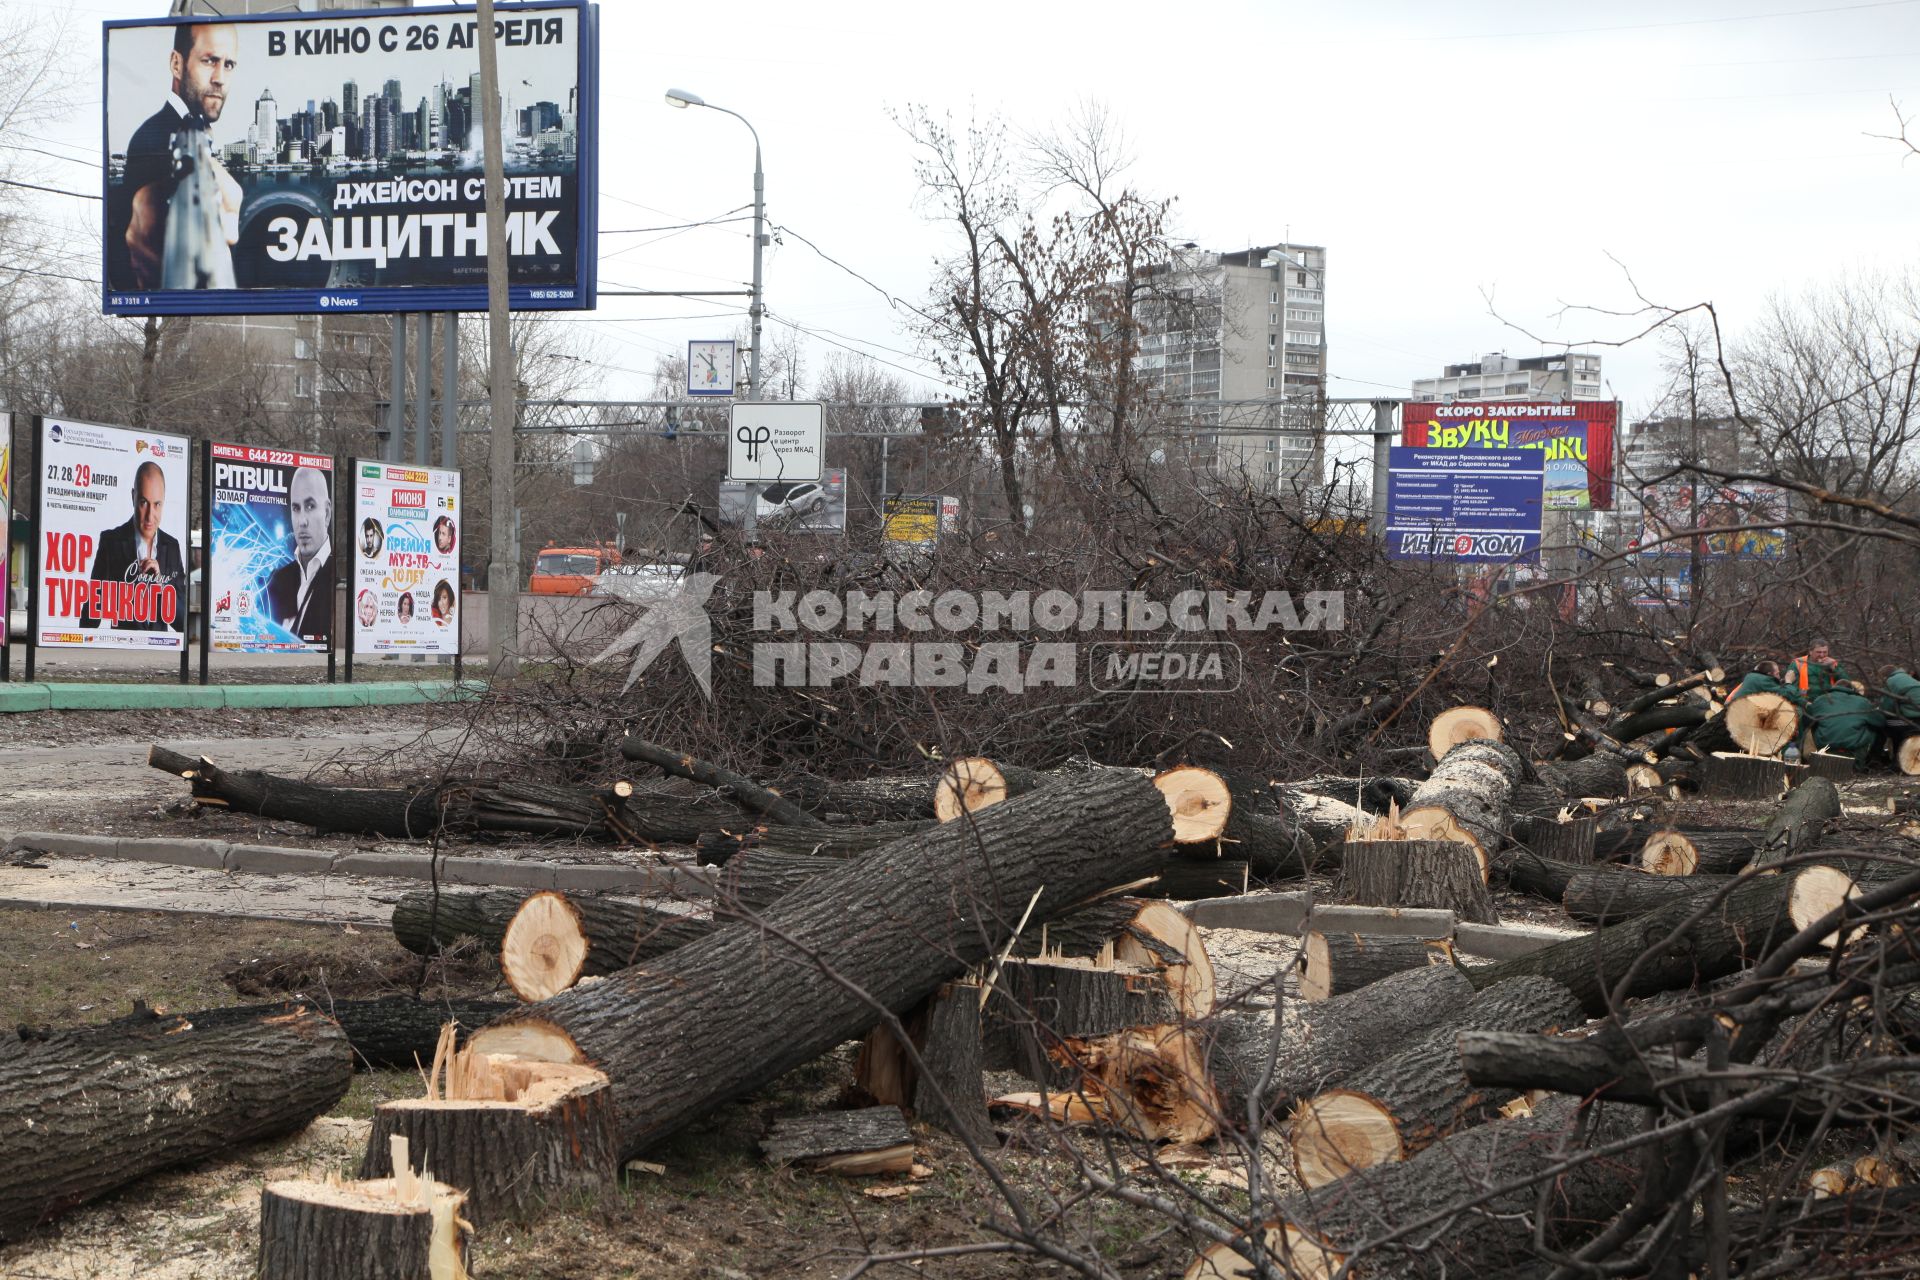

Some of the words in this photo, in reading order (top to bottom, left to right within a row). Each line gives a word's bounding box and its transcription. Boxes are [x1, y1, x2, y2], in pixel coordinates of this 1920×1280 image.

[268, 30, 287, 57] В
[295, 25, 371, 56] КИНО
[379, 25, 398, 53] С
[406, 24, 439, 51] 26
[333, 175, 458, 210] ДЖЕЙСОН
[266, 210, 562, 269] ЗАЩИТНИК
[1435, 406, 1484, 418] СКОРО
[1487, 405, 1576, 417] ЗАКРЫТИЕ!
[774, 429, 806, 438] Разворот
[779, 438, 800, 446] центр
[213, 445, 244, 457] БИЛЕТЫ:
[248, 449, 268, 461] 644
[269, 452, 294, 465] 2222
[793, 446, 814, 454] МКАД
[1413, 453, 1458, 462] Реконструкция
[1460, 455, 1502, 463] Ярославского
[75, 464, 91, 488] 29
[91, 473, 118, 488] АПРЕЛЯ
[215, 462, 288, 494] PITBULL
[414, 472, 429, 484] 2222
[47, 486, 85, 499] ПРАЗДНИЧНЫЙ
[86, 490, 108, 501] КОНЦЕРТ
[216, 490, 227, 501] 30
[226, 491, 245, 503] МАЯ
[398, 491, 423, 506] ИЮНЯ
[45, 531, 93, 573] ХОР
[386, 536, 431, 554] ПРЕМИЯ
[389, 553, 430, 569] МУЗ-ТВ
[392, 569, 405, 583] 10
[45, 577, 177, 628] ТУРЕЦКОГО
